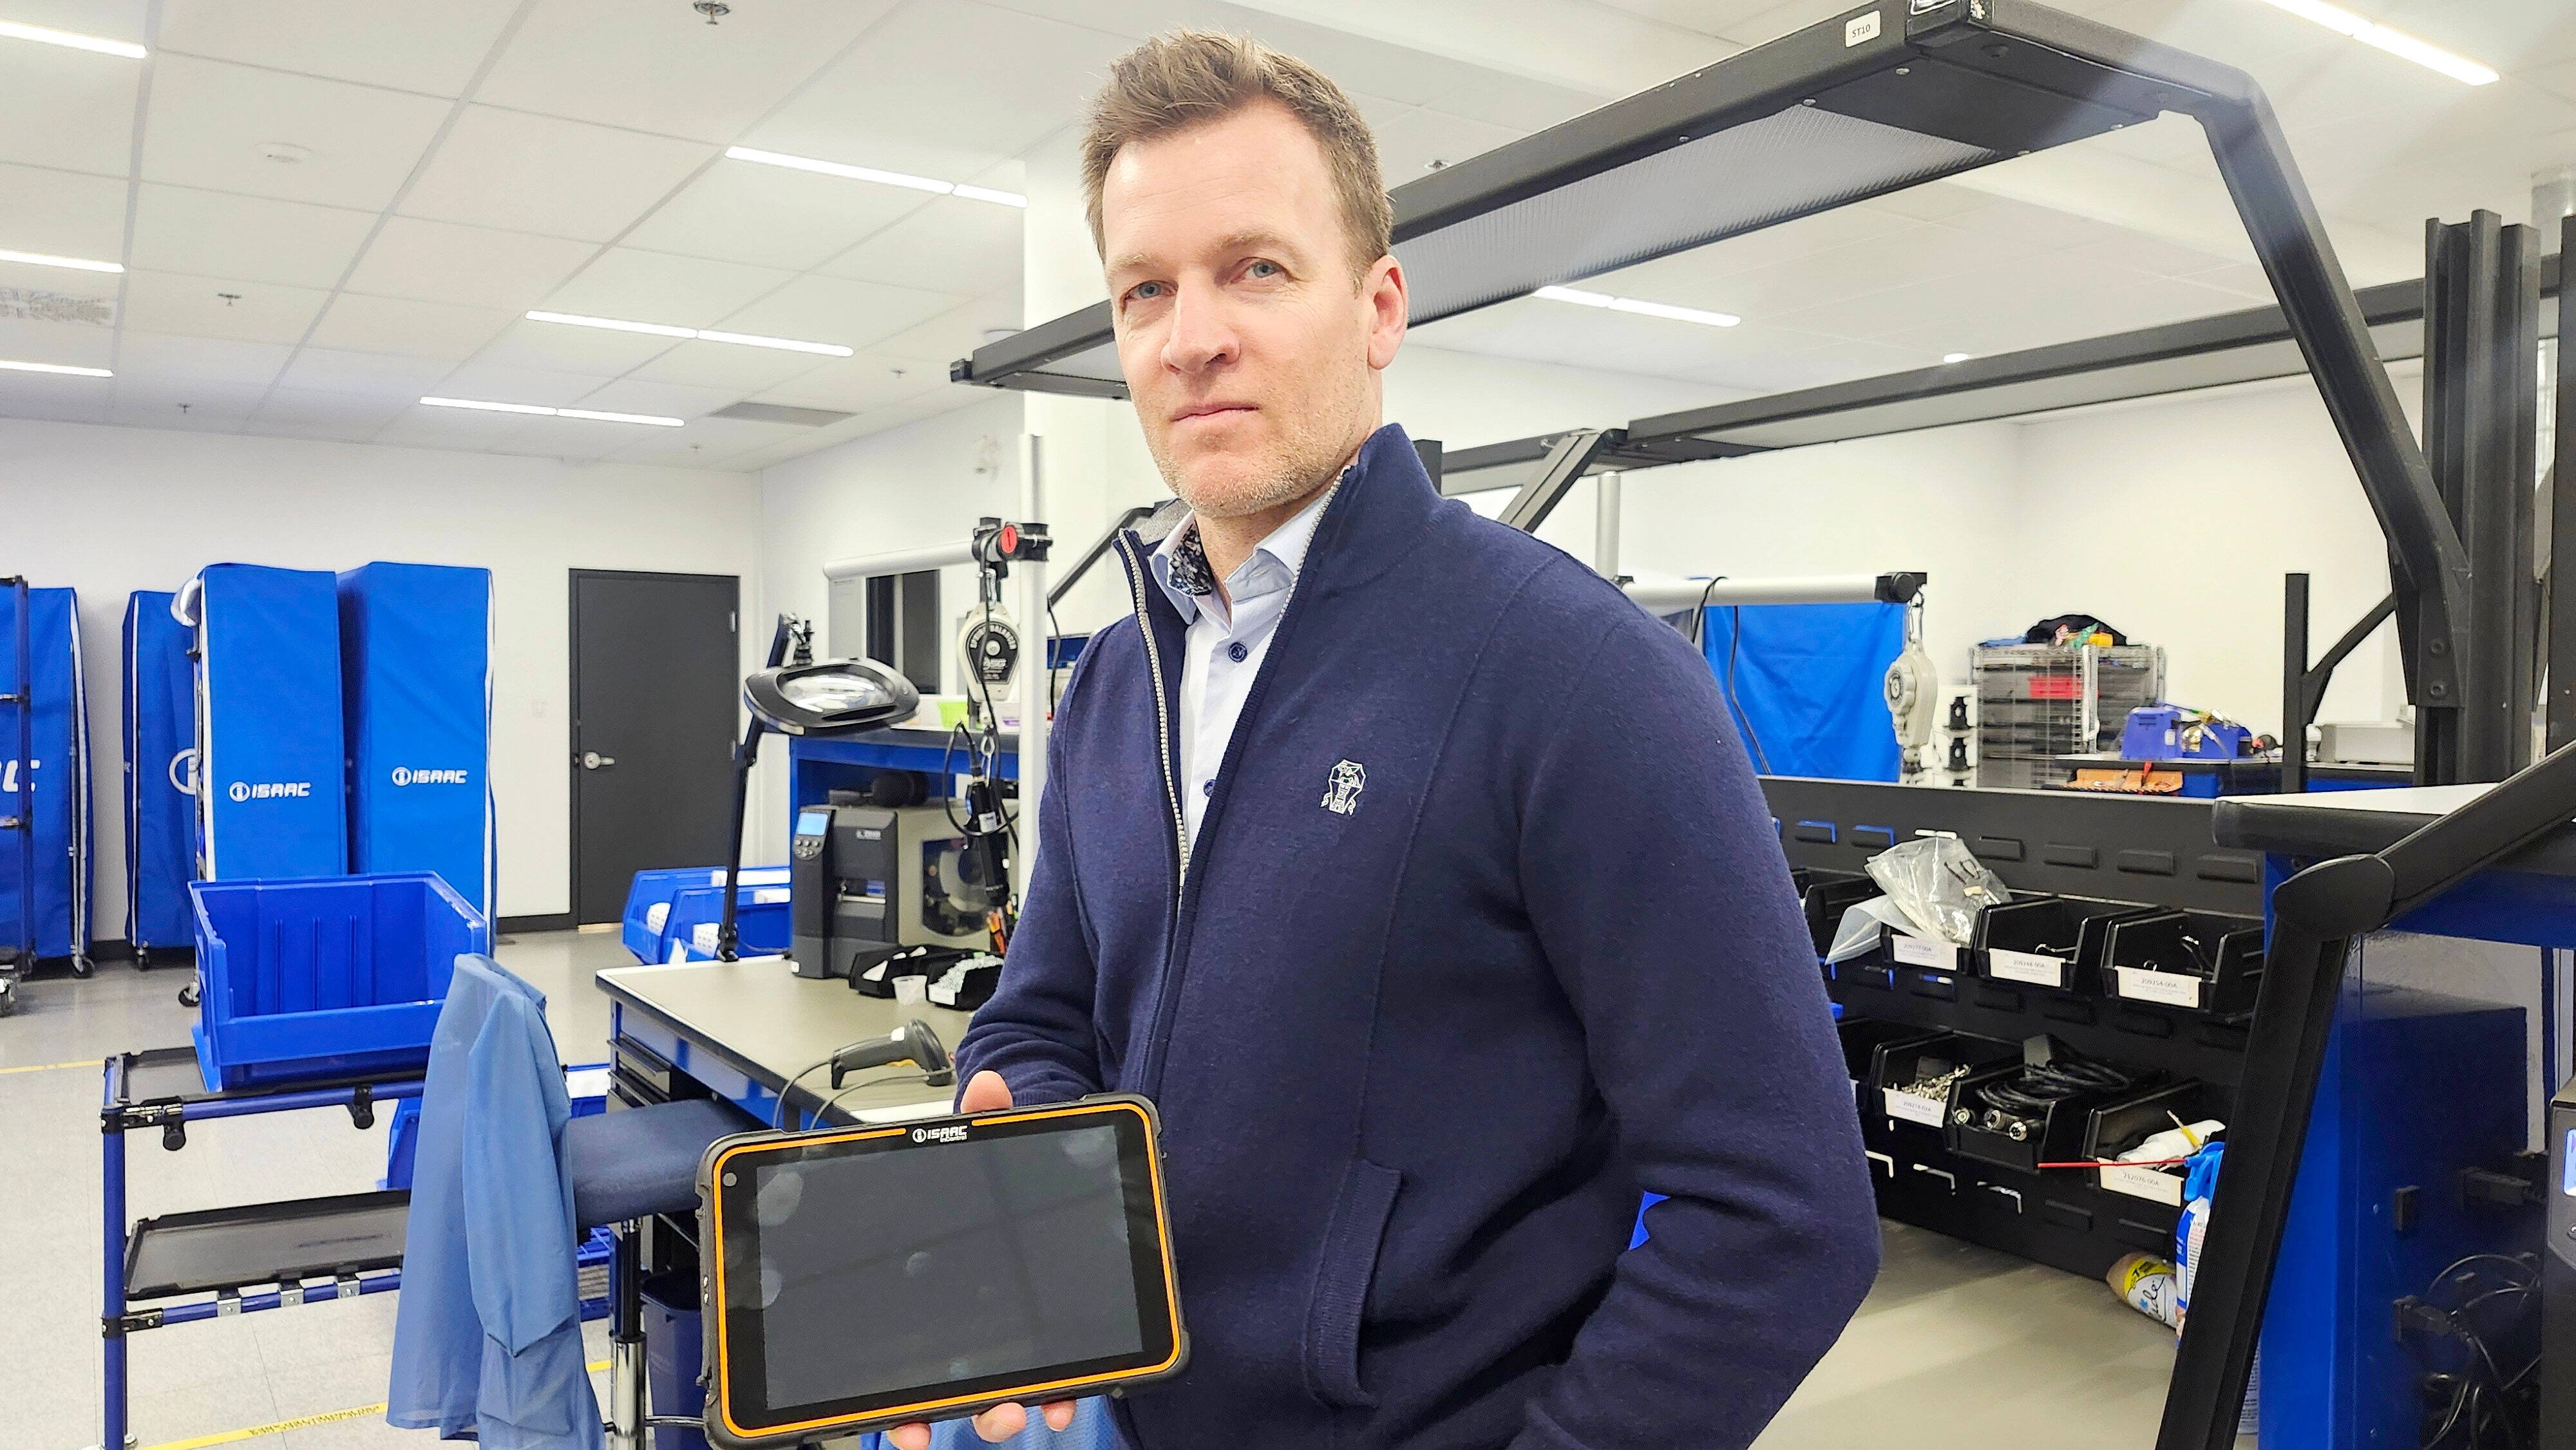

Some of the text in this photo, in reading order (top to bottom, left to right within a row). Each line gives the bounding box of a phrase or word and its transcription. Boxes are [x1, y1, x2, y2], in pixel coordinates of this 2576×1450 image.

[1852, 24, 1871, 39] ST10
[412, 769, 468, 784] ISAAC
[251, 782, 311, 799] ISAAC
[927, 1125, 967, 1140] ISAAC
